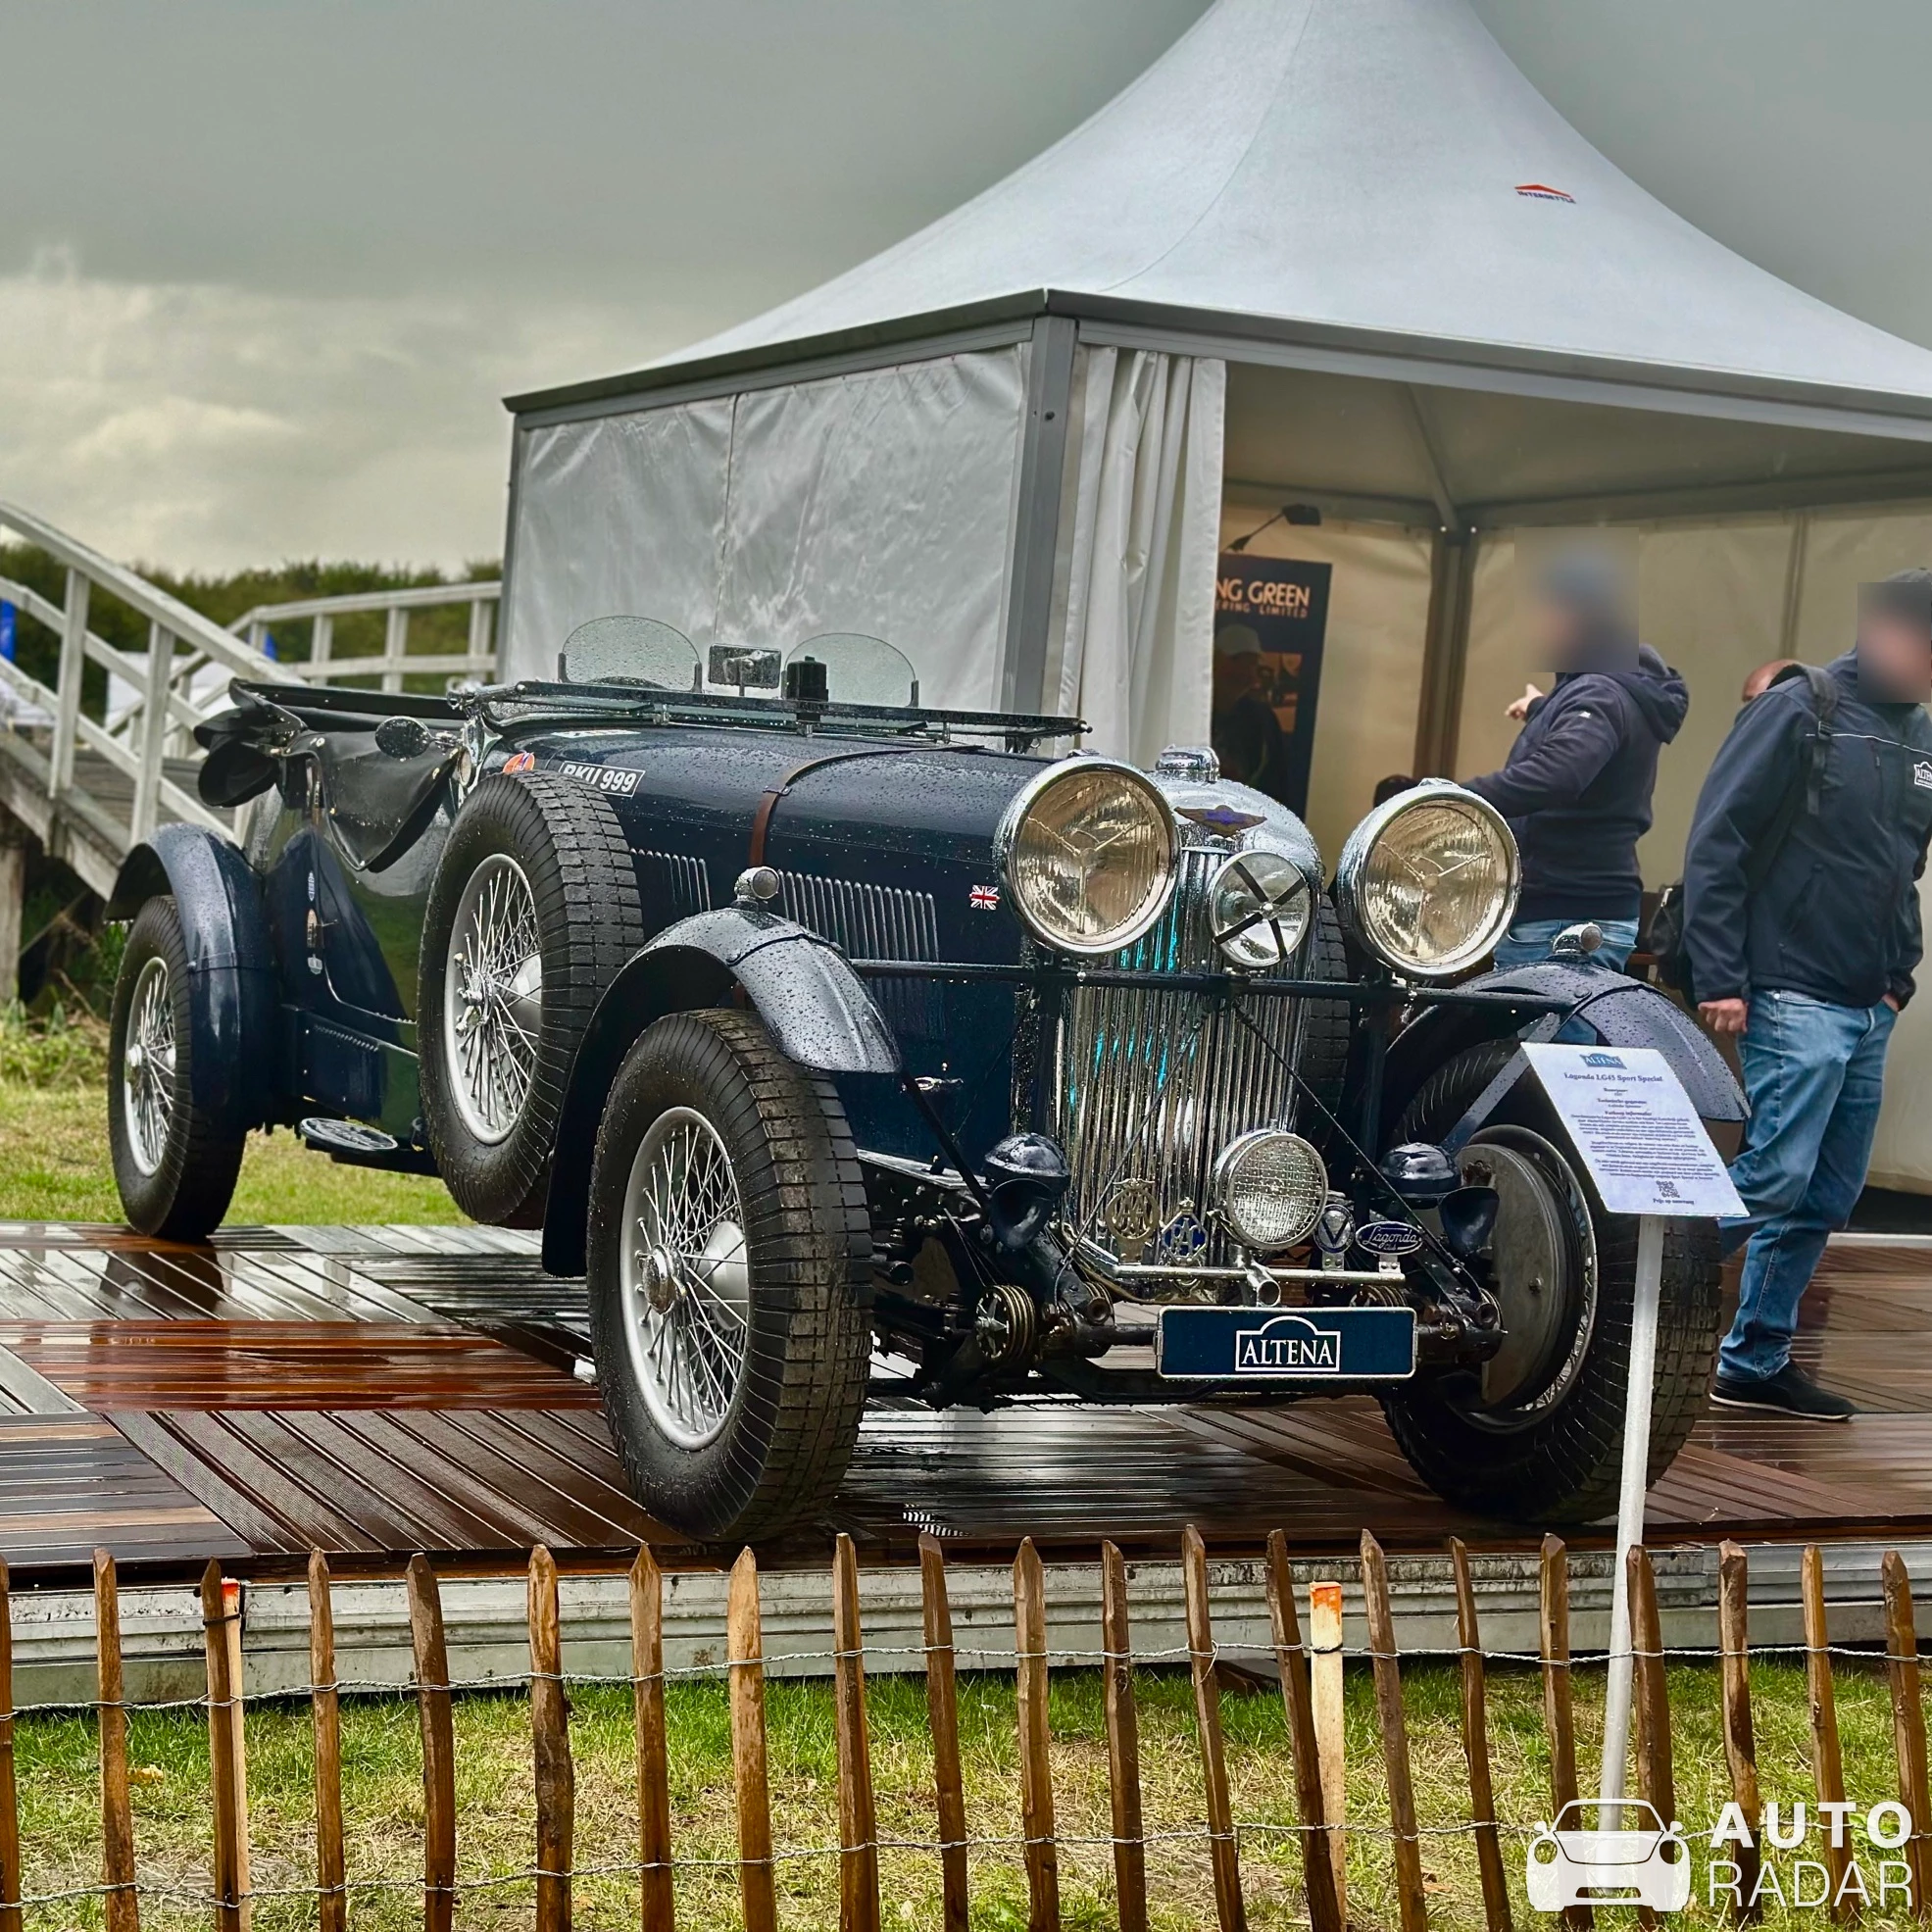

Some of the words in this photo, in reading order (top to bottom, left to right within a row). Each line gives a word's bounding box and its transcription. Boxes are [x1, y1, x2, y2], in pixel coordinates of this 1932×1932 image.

[1248, 580, 1311, 607] GREEN
[1259, 605, 1309, 619] LIMITED
[600, 769, 637, 792] 999
[1584, 1056, 1622, 1066] ALTENA
[1563, 1072, 1595, 1081] Lagonda
[1617, 1074, 1637, 1083] Sport
[1362, 1225, 1418, 1250] Lagonda
[1241, 1339, 1334, 1364] ALTENA
